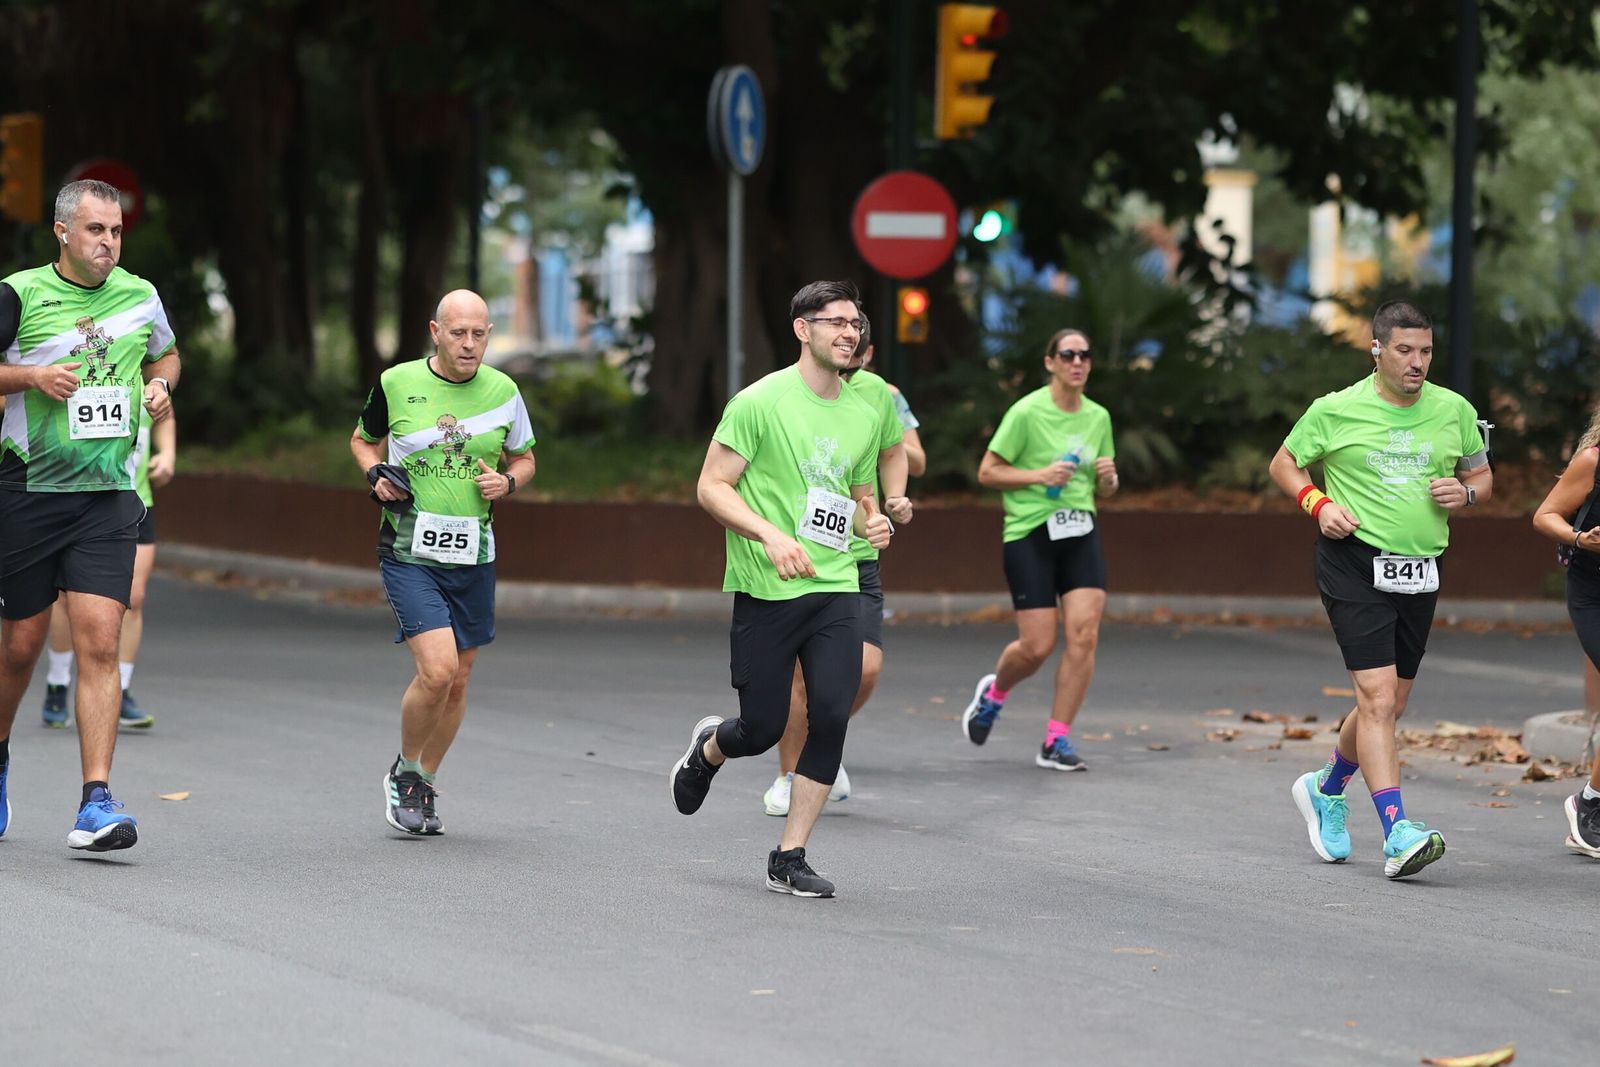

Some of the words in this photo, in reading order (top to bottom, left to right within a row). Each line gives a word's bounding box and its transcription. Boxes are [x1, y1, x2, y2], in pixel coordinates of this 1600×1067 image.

[78, 404, 122, 423] 914
[811, 507, 847, 534] 508
[422, 530, 469, 549] 925
[1383, 562, 1424, 580] 841
